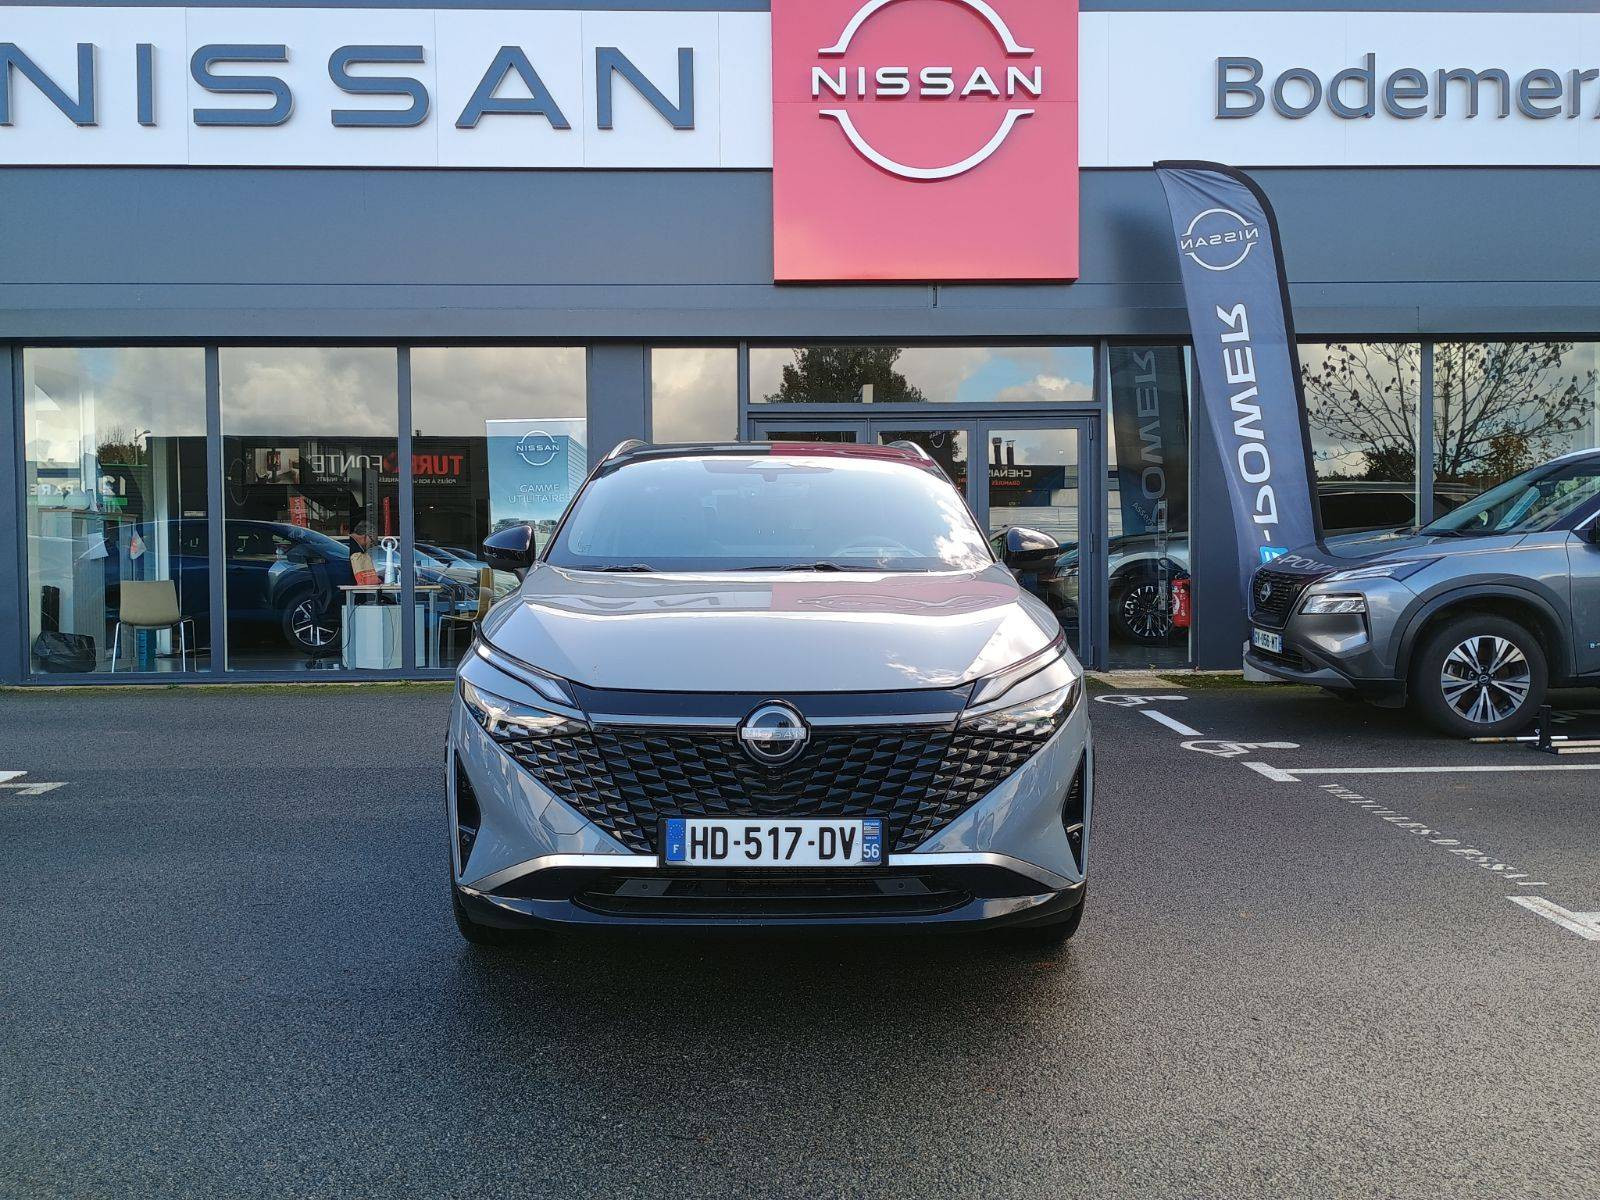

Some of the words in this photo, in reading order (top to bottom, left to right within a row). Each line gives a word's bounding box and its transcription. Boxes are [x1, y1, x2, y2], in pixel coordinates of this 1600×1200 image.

[0, 42, 695, 131] NISSAN
[811, 66, 1042, 99] NISSAN
[1214, 53, 1600, 121] Bodemer
[516, 444, 560, 452] NISSAN
[519, 484, 560, 493] GAMME
[673, 844, 680, 854] F
[863, 843, 880, 859] 56
[690, 826, 857, 860] HD-517-DV
